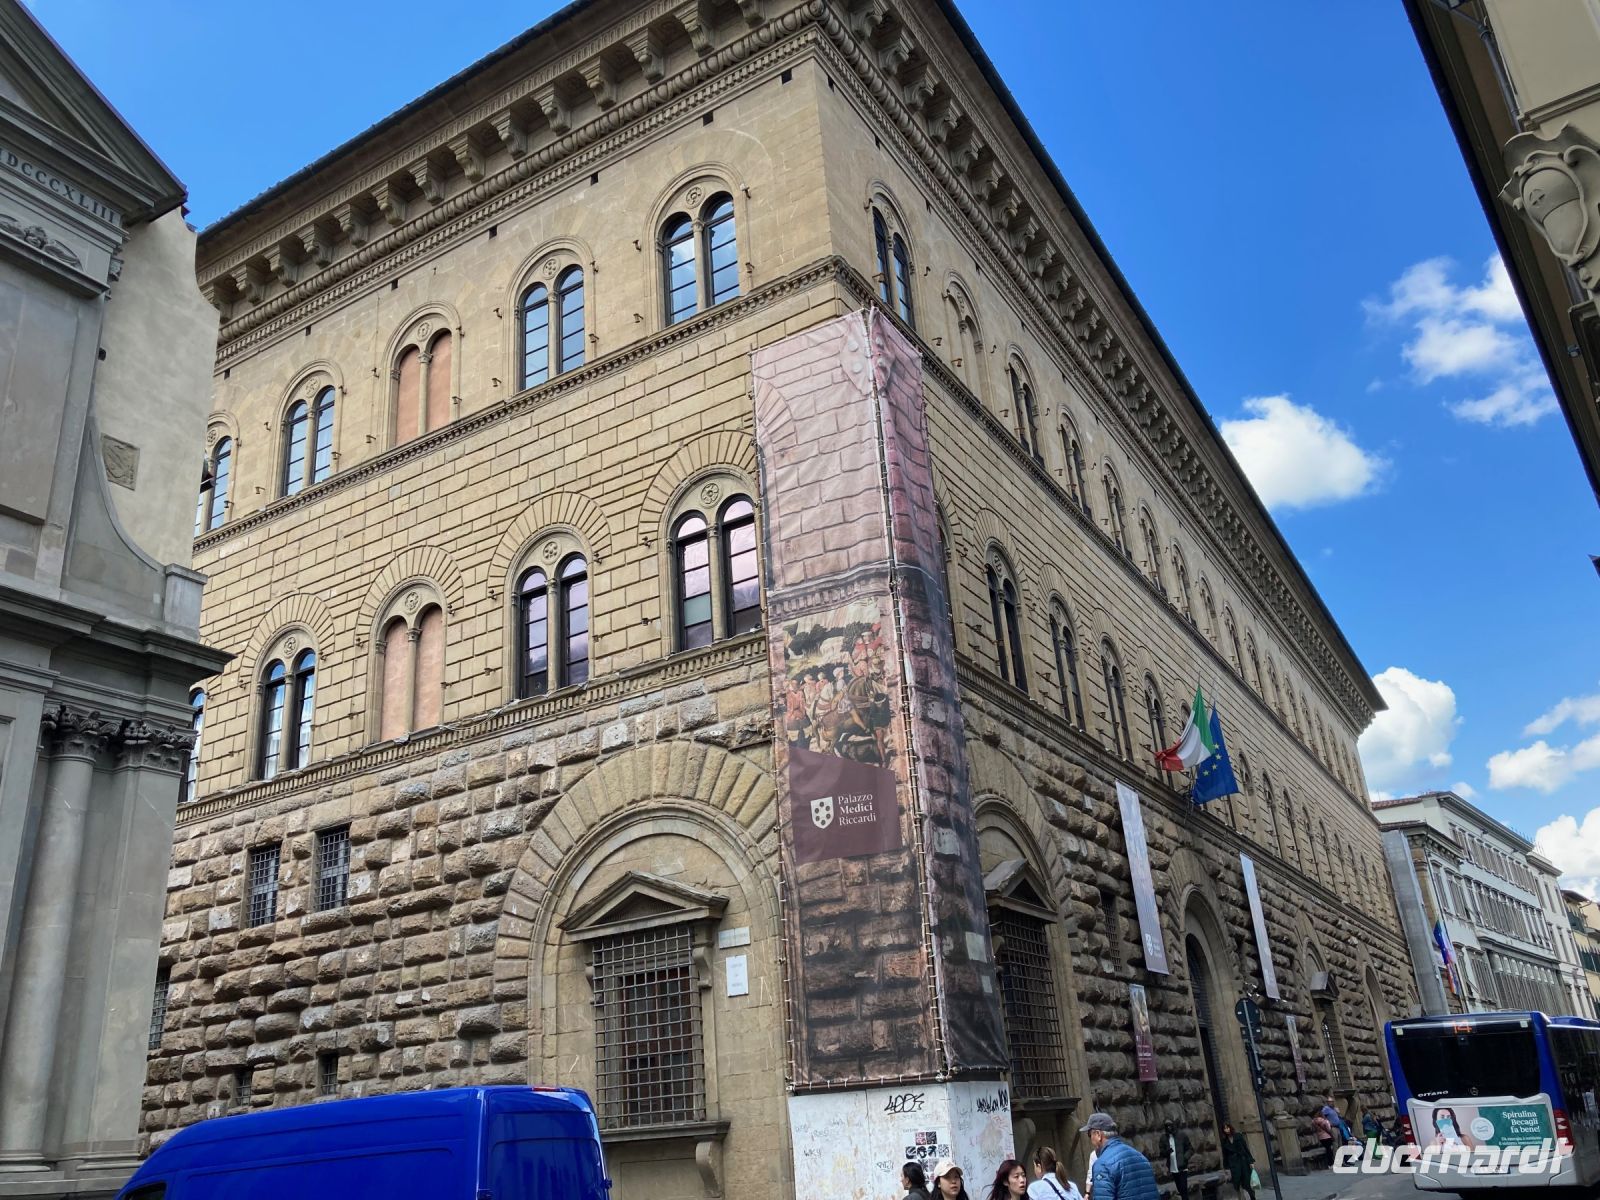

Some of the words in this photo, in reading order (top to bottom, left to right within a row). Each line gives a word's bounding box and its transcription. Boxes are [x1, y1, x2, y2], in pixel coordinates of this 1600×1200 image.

[0, 148, 115, 223] DCCCXLIII
[838, 793, 873, 805] Palazzo
[840, 803, 873, 815] Medici
[839, 813, 877, 826] Riccardi
[1417, 1090, 1449, 1098] CITARO
[1502, 1110, 1537, 1119] Spirulina
[1511, 1118, 1539, 1126] Becagli
[1519, 1125, 1541, 1133] bene!
